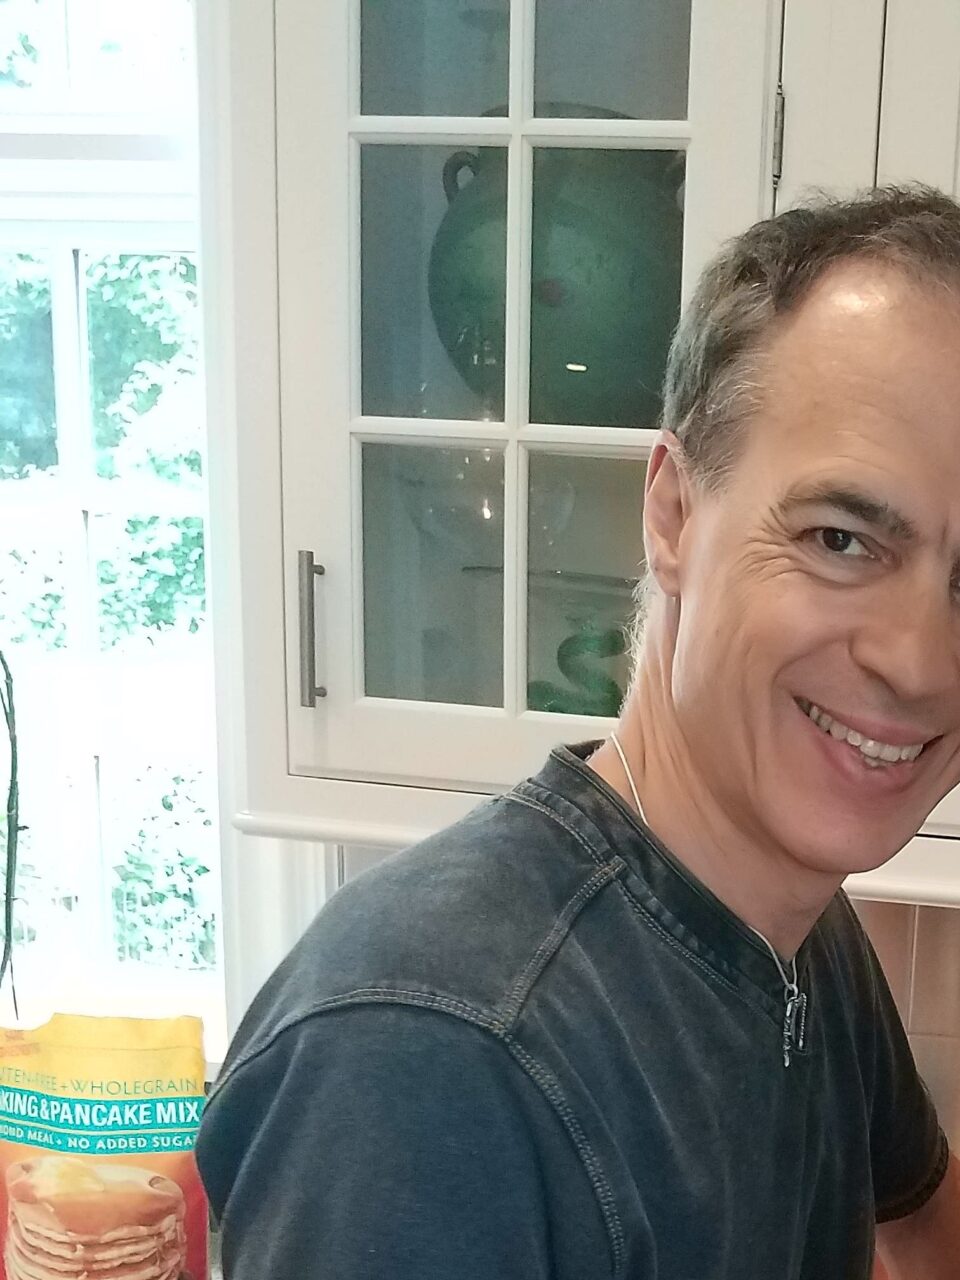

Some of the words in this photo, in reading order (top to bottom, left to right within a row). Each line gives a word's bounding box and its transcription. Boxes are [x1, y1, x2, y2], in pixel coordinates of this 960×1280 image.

[156, 1101, 200, 1124] MIX
[28, 1129, 54, 1145] MEAL
[67, 1137, 90, 1149] NO
[96, 1137, 147, 1150] ADDED
